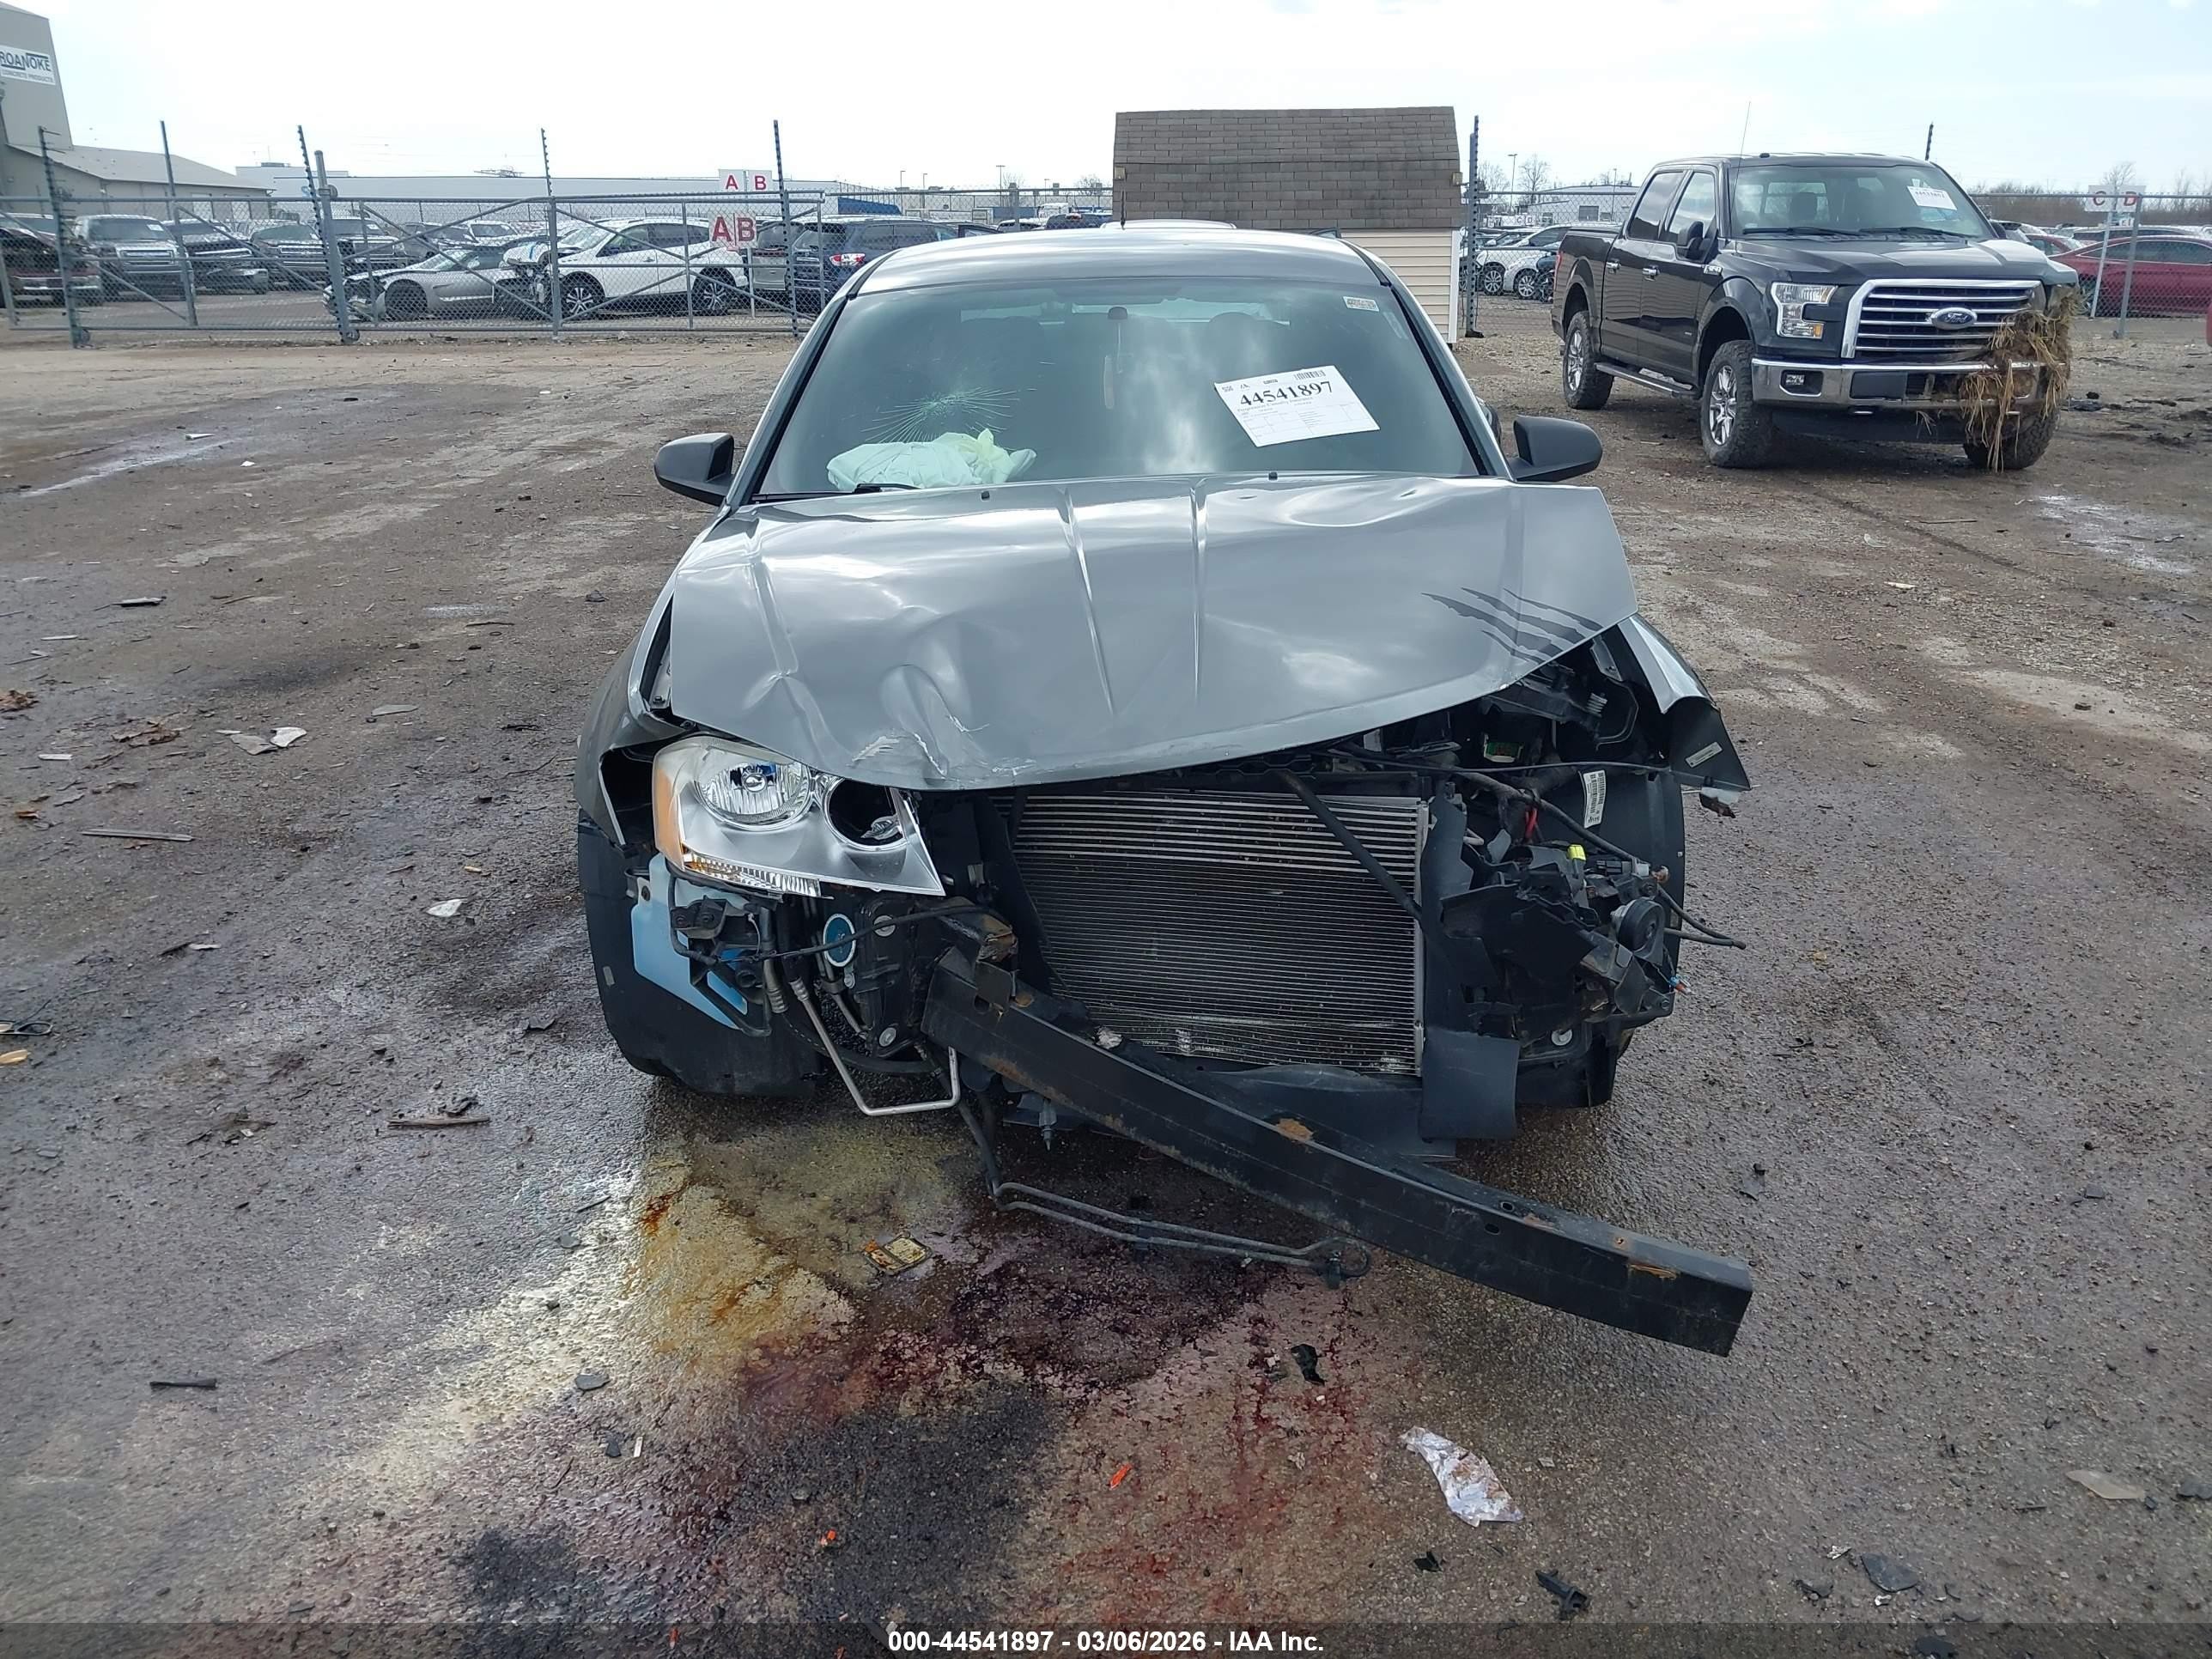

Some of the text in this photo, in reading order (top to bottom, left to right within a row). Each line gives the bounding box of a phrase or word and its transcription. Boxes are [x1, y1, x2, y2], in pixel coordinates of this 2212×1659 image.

[0, 51, 52, 72] ROANOKE
[725, 174, 767, 190] A B
[2094, 191, 2137, 206] C D
[712, 216, 755, 241] A B
[1944, 313, 1969, 324] Ford
[1240, 380, 1332, 406] 44541897
